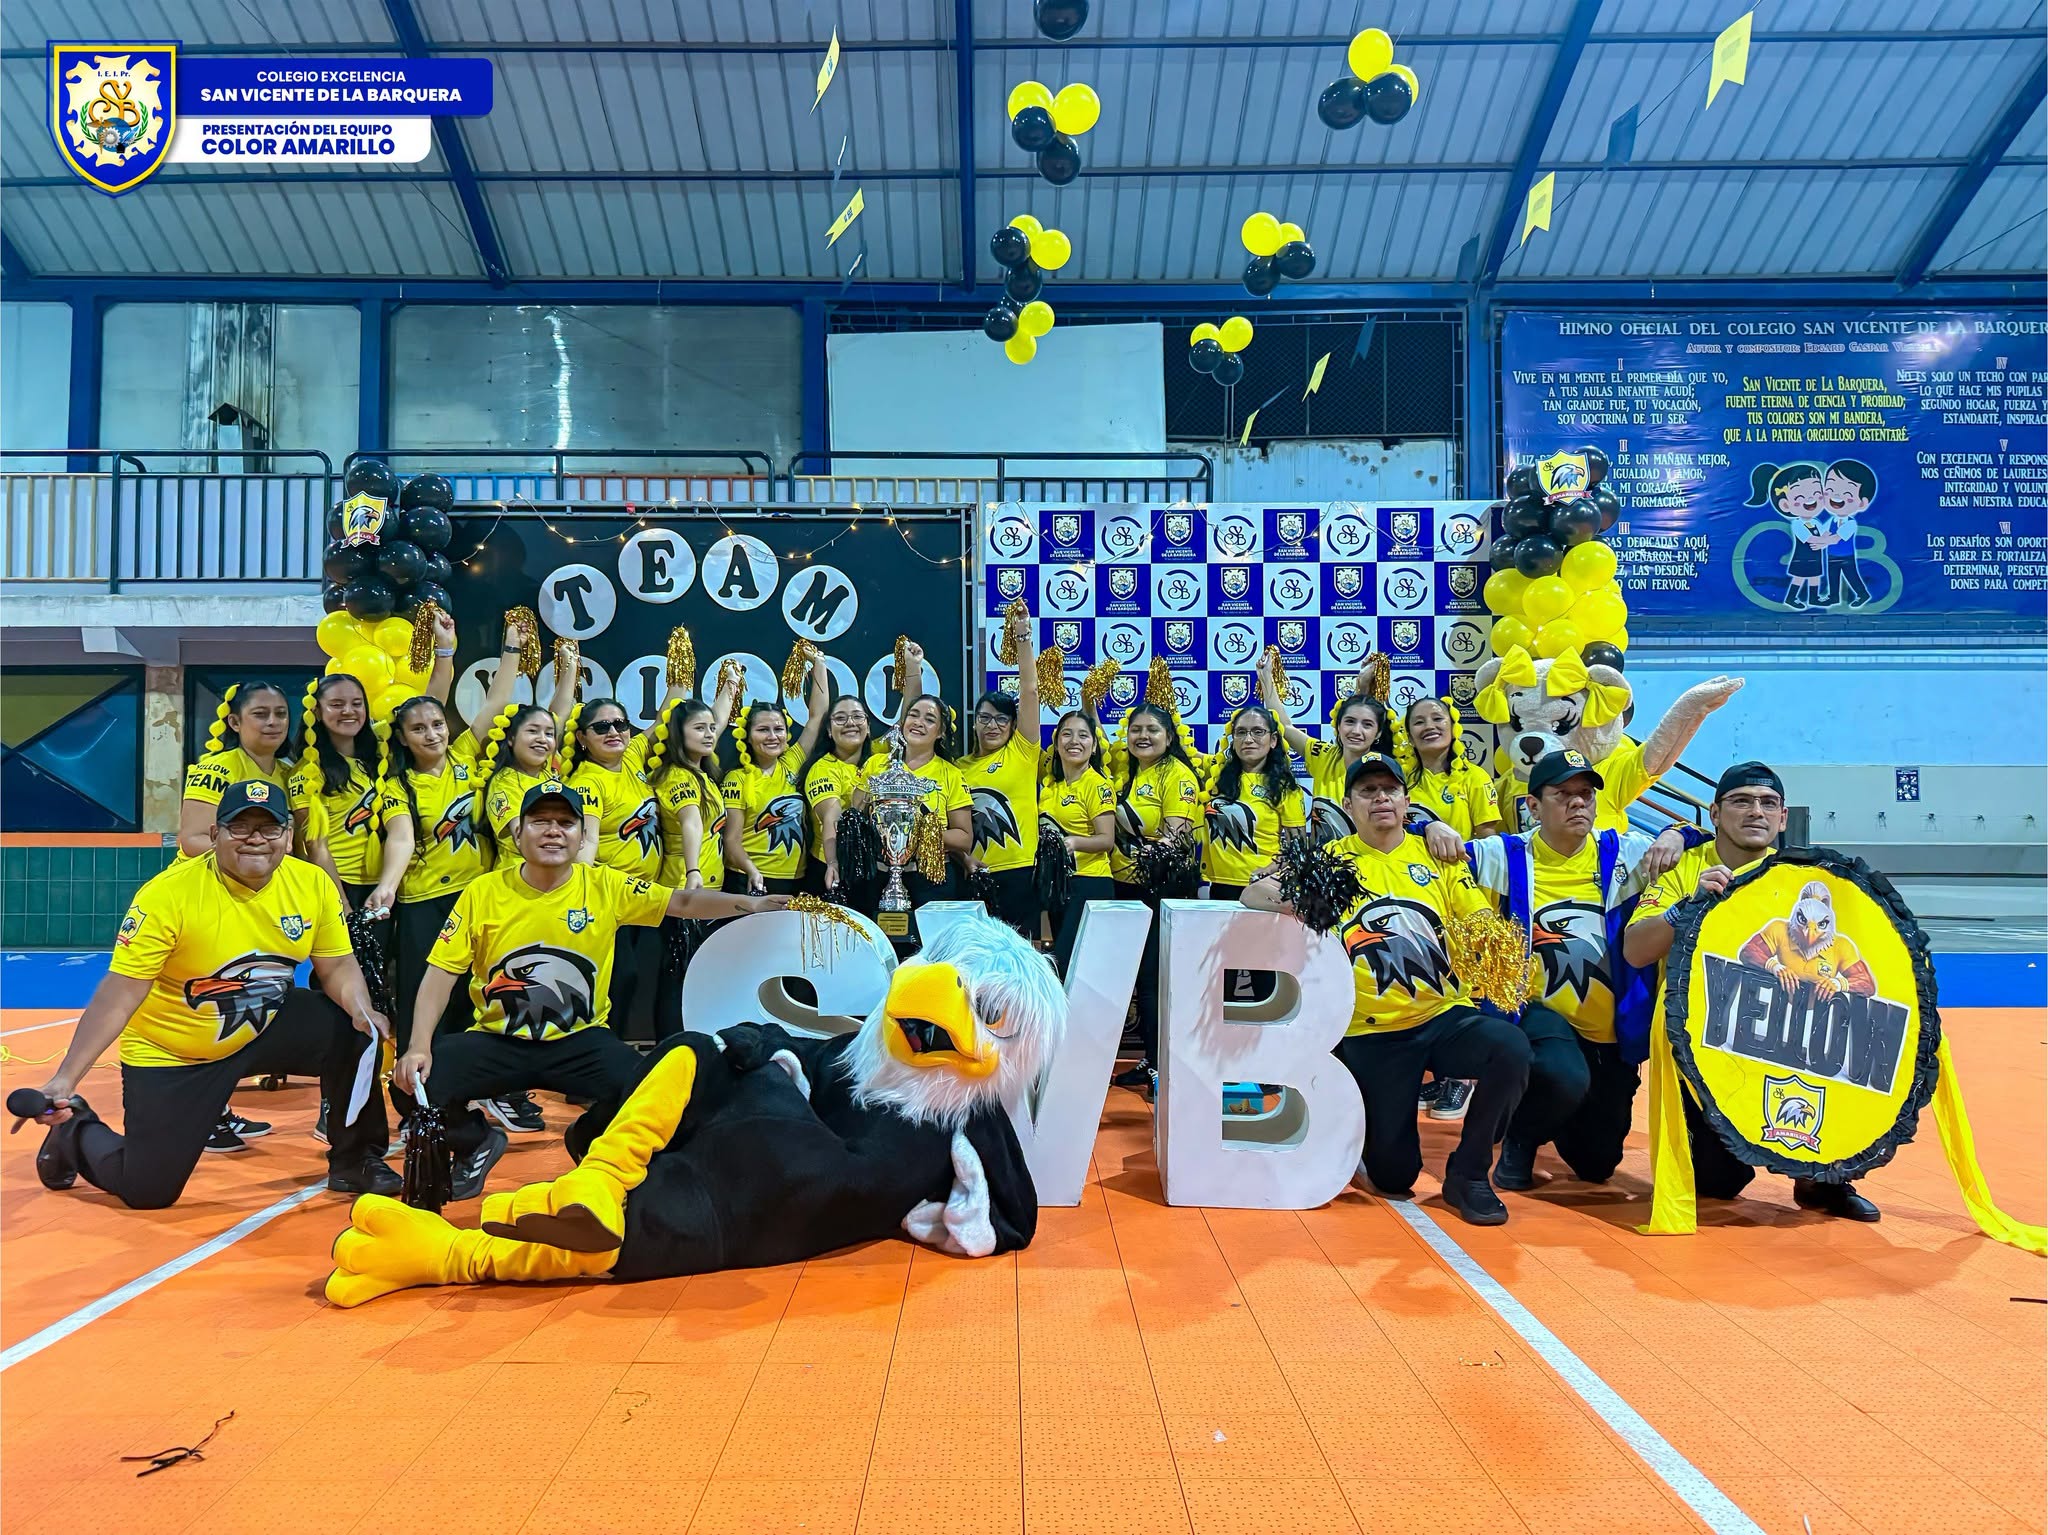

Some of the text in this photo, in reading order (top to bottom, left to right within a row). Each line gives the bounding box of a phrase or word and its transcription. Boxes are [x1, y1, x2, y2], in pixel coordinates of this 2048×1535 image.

[1559, 322, 1612, 335] HIMNO
[1620, 322, 1682, 335] OFICIAL
[1690, 322, 1720, 335] DEL
[1728, 322, 1796, 335] COLEGIO
[1804, 322, 1834, 335] SAN
[1842, 322, 1914, 335] VICENTE
[1918, 322, 1938, 335] DE
[1946, 322, 1967, 335] LA
[1512, 370, 1728, 386] VIVE EN MI MENTE EL PRIMER DÍA QUE YO,
[1896, 369, 2026, 382] NO ES SOLO UN TECHO CON
[1548, 386, 1555, 397] A
[1560, 386, 1578, 397] TUS
[1584, 386, 1613, 397] AULAS
[1664, 385, 1695, 398] ACUDÍ;
[1743, 376, 1887, 394] SAN VICENTE DE LA BARQUERA,
[1920, 386, 2042, 397] LO QUE HACE MIS PUPILAS
[1543, 398, 1701, 412] TAN GRANDE FUE, TU VOCACIÓN,
[1726, 396, 1907, 408] FUENTE ETERNA DE CIENCIA Y PROBIDAD;
[1921, 400, 2037, 412] SEGUNDO HOGAR, FUERZA
[1558, 414, 1687, 424] SOY DOCTRINA DE TU SER.
[1747, 412, 1886, 426] TUS COLORES SON MI BANDERA,
[1943, 413, 2002, 426] ESTANDARTE,
[1724, 428, 1855, 444] QUE A LA PATRIA ORGULLOSO
[1516, 452, 1535, 465] LUZ
[1618, 454, 1630, 465] DE
[1636, 454, 1648, 465] UN
[1654, 452, 1693, 465] MAÑANA
[1698, 454, 1730, 467] MEJOR,
[1916, 452, 2004, 464] CON EXCELENCIA Y
[1613, 468, 1660, 479] IGUALDAD
[1922, 468, 1939, 478] NOS
[1944, 466, 1982, 478] CEÑIMOS
[1987, 468, 1998, 478] DE
[1620, 482, 1631, 494] MI
[1945, 482, 2009, 493] INTEGRIDAD Y
[1631, 494, 1687, 507] FORMACIÓN.
[1940, 496, 2013, 507] BASAN NUESTRA
[1628, 537, 1679, 548] DEDICADAS
[1684, 534, 1710, 549] AQUÍ,
[1927, 534, 2012, 547] LOS DESAFÍOS SON
[1677, 552, 1708, 563] EN MÍ;
[1934, 551, 1944, 561] EL
[1949, 551, 1976, 561] SABER
[1982, 551, 1992, 561] ES
[1633, 564, 1650, 576] LAS
[1654, 562, 1698, 578] DESDEÑÉ,
[1944, 565, 2002, 578] DETERMINAR,
[554, 540, 850, 636] TEAM
[1628, 579, 1647, 590] CON
[1652, 579, 1690, 590] FERVOR.
[1950, 579, 2008, 590] DONES PARA
[670, 790, 697, 806] TEAM
[808, 784, 834, 799] TEAM
[1703, 954, 1908, 1092] YELLOW
[1776, 1131, 1808, 1140] AMARILLO
